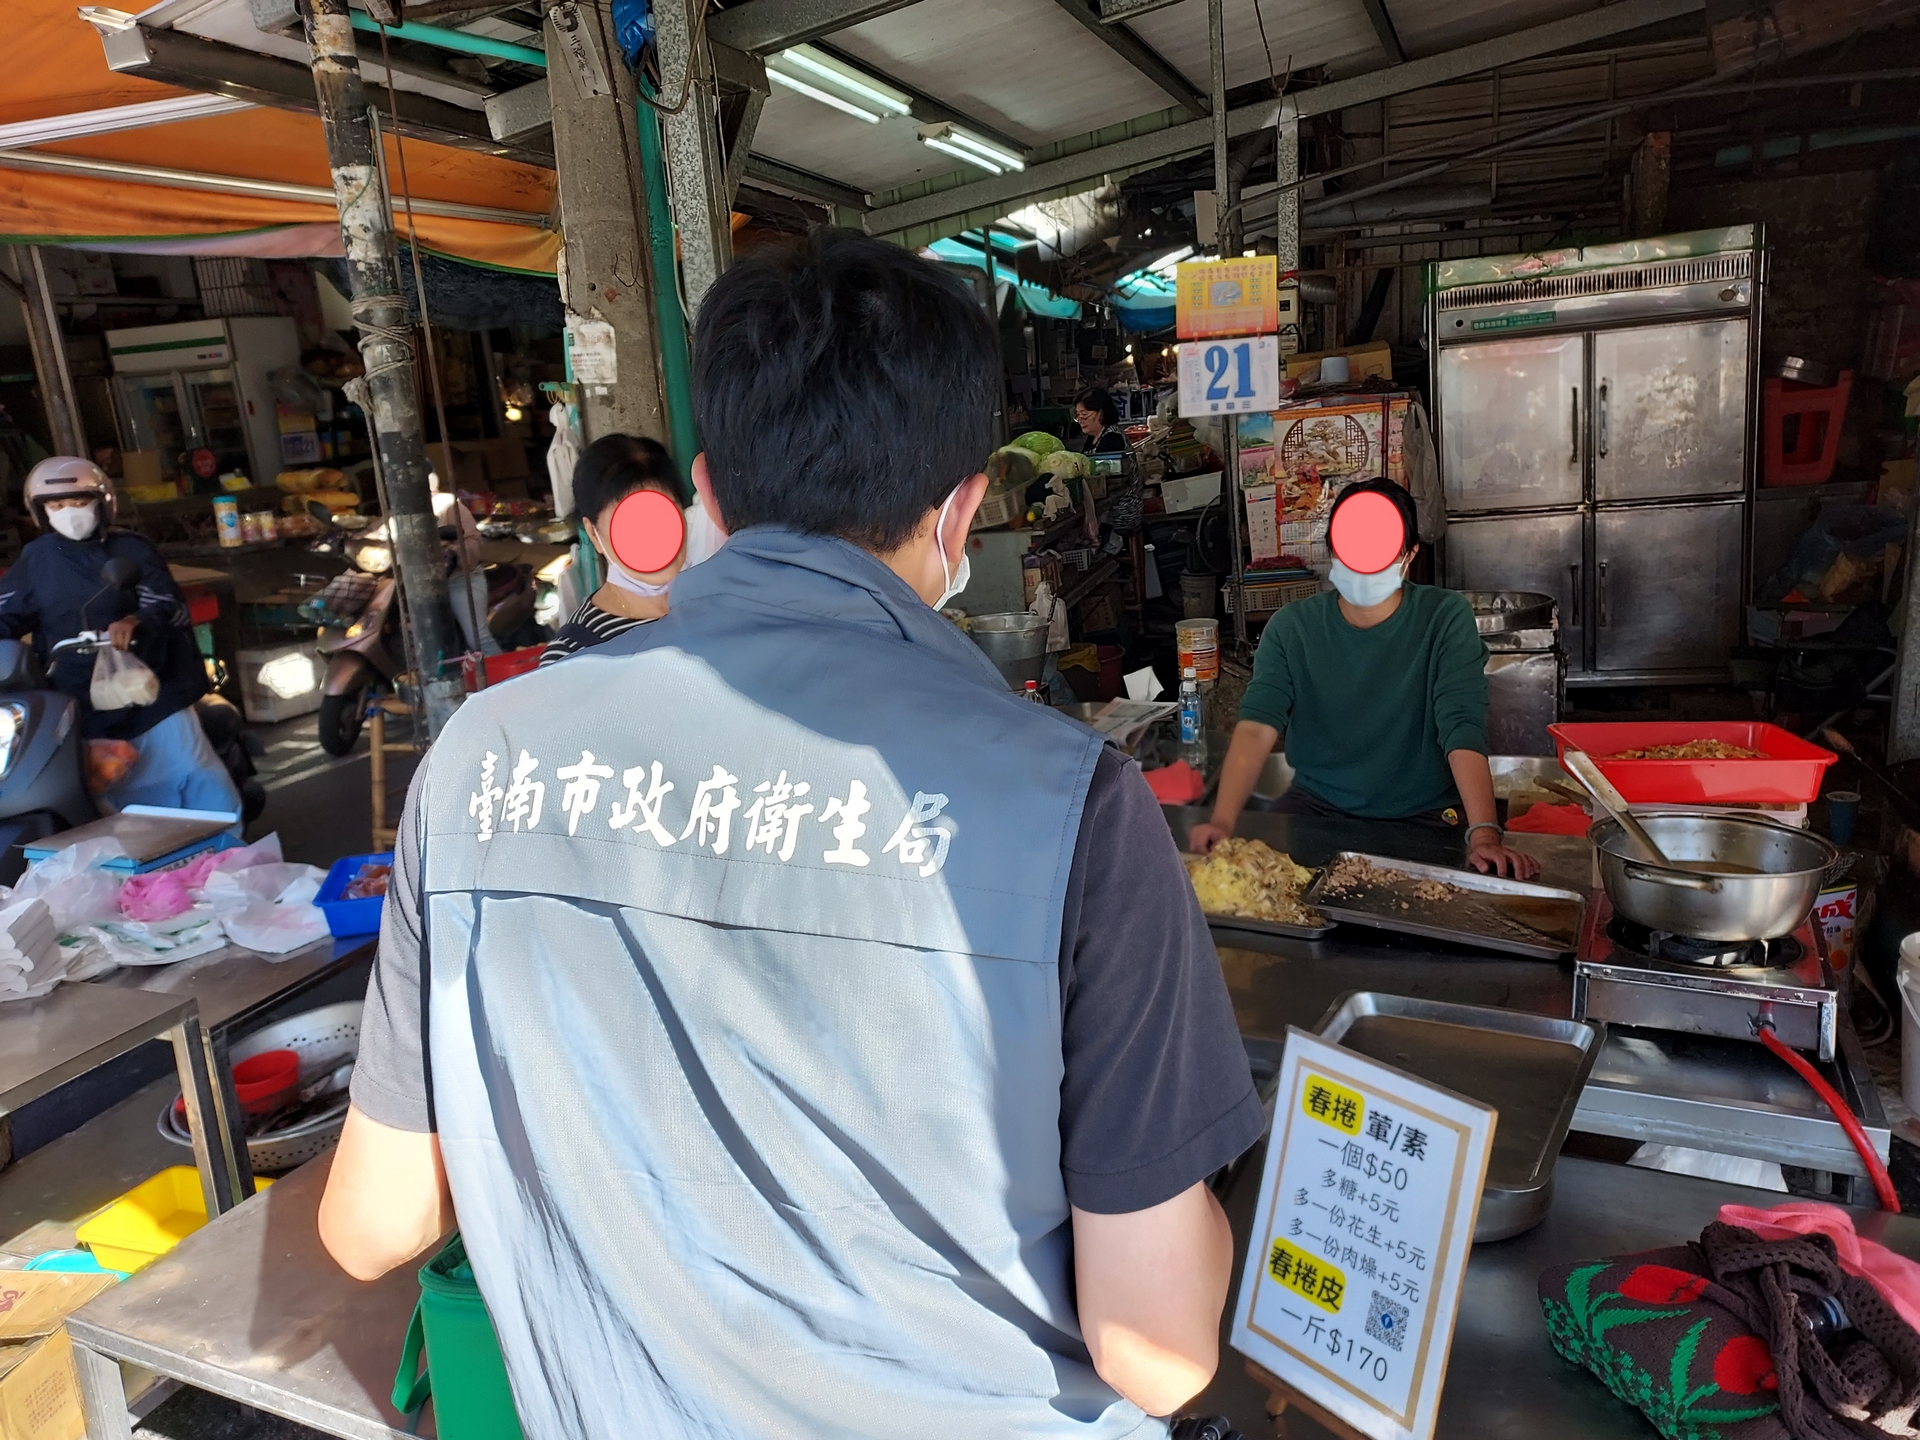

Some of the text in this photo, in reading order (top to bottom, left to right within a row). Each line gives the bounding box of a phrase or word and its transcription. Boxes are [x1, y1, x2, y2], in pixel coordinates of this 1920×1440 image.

[1204, 343, 1256, 400] 21
[1210, 400, 1251, 412] 星期三
[468, 749, 954, 879] 臺南市政府衛生局
[1308, 1085, 1429, 1162] 春捲 葷/素
[1318, 1137, 1408, 1191] 一個$50
[1320, 1168, 1400, 1223] 多糖+5元
[1288, 1217, 1420, 1304] 多一份肉燥+5元
[1294, 1187, 1427, 1271] 多一份花生+5元
[1269, 1245, 1345, 1311] 春捲皮
[1281, 1307, 1389, 1382] 一斤$170
